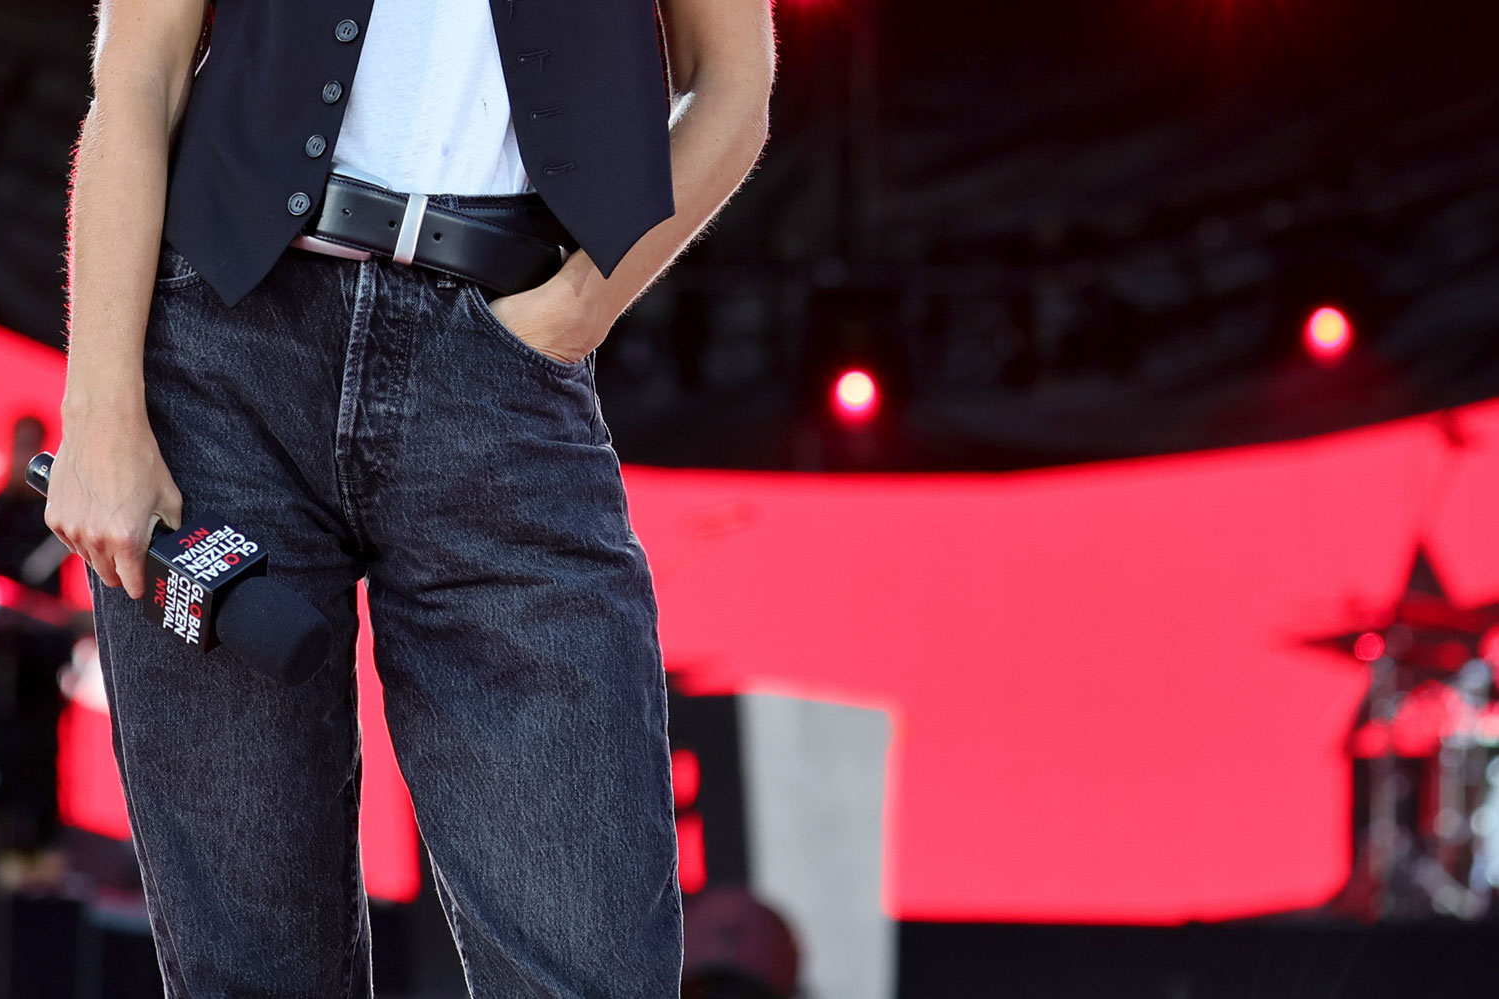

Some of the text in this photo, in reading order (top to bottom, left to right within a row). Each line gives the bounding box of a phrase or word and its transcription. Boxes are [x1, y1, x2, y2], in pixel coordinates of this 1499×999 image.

[171, 525, 235, 564] FESTIVAL
[179, 527, 210, 549] NYC
[185, 533, 246, 574] CITIZEN
[194, 541, 258, 582] GLOBAL
[154, 577, 167, 608] NYC
[163, 568, 179, 629] FESTIVAL
[174, 576, 191, 638] CITIZEN
[186, 583, 204, 644] GLOBAL
